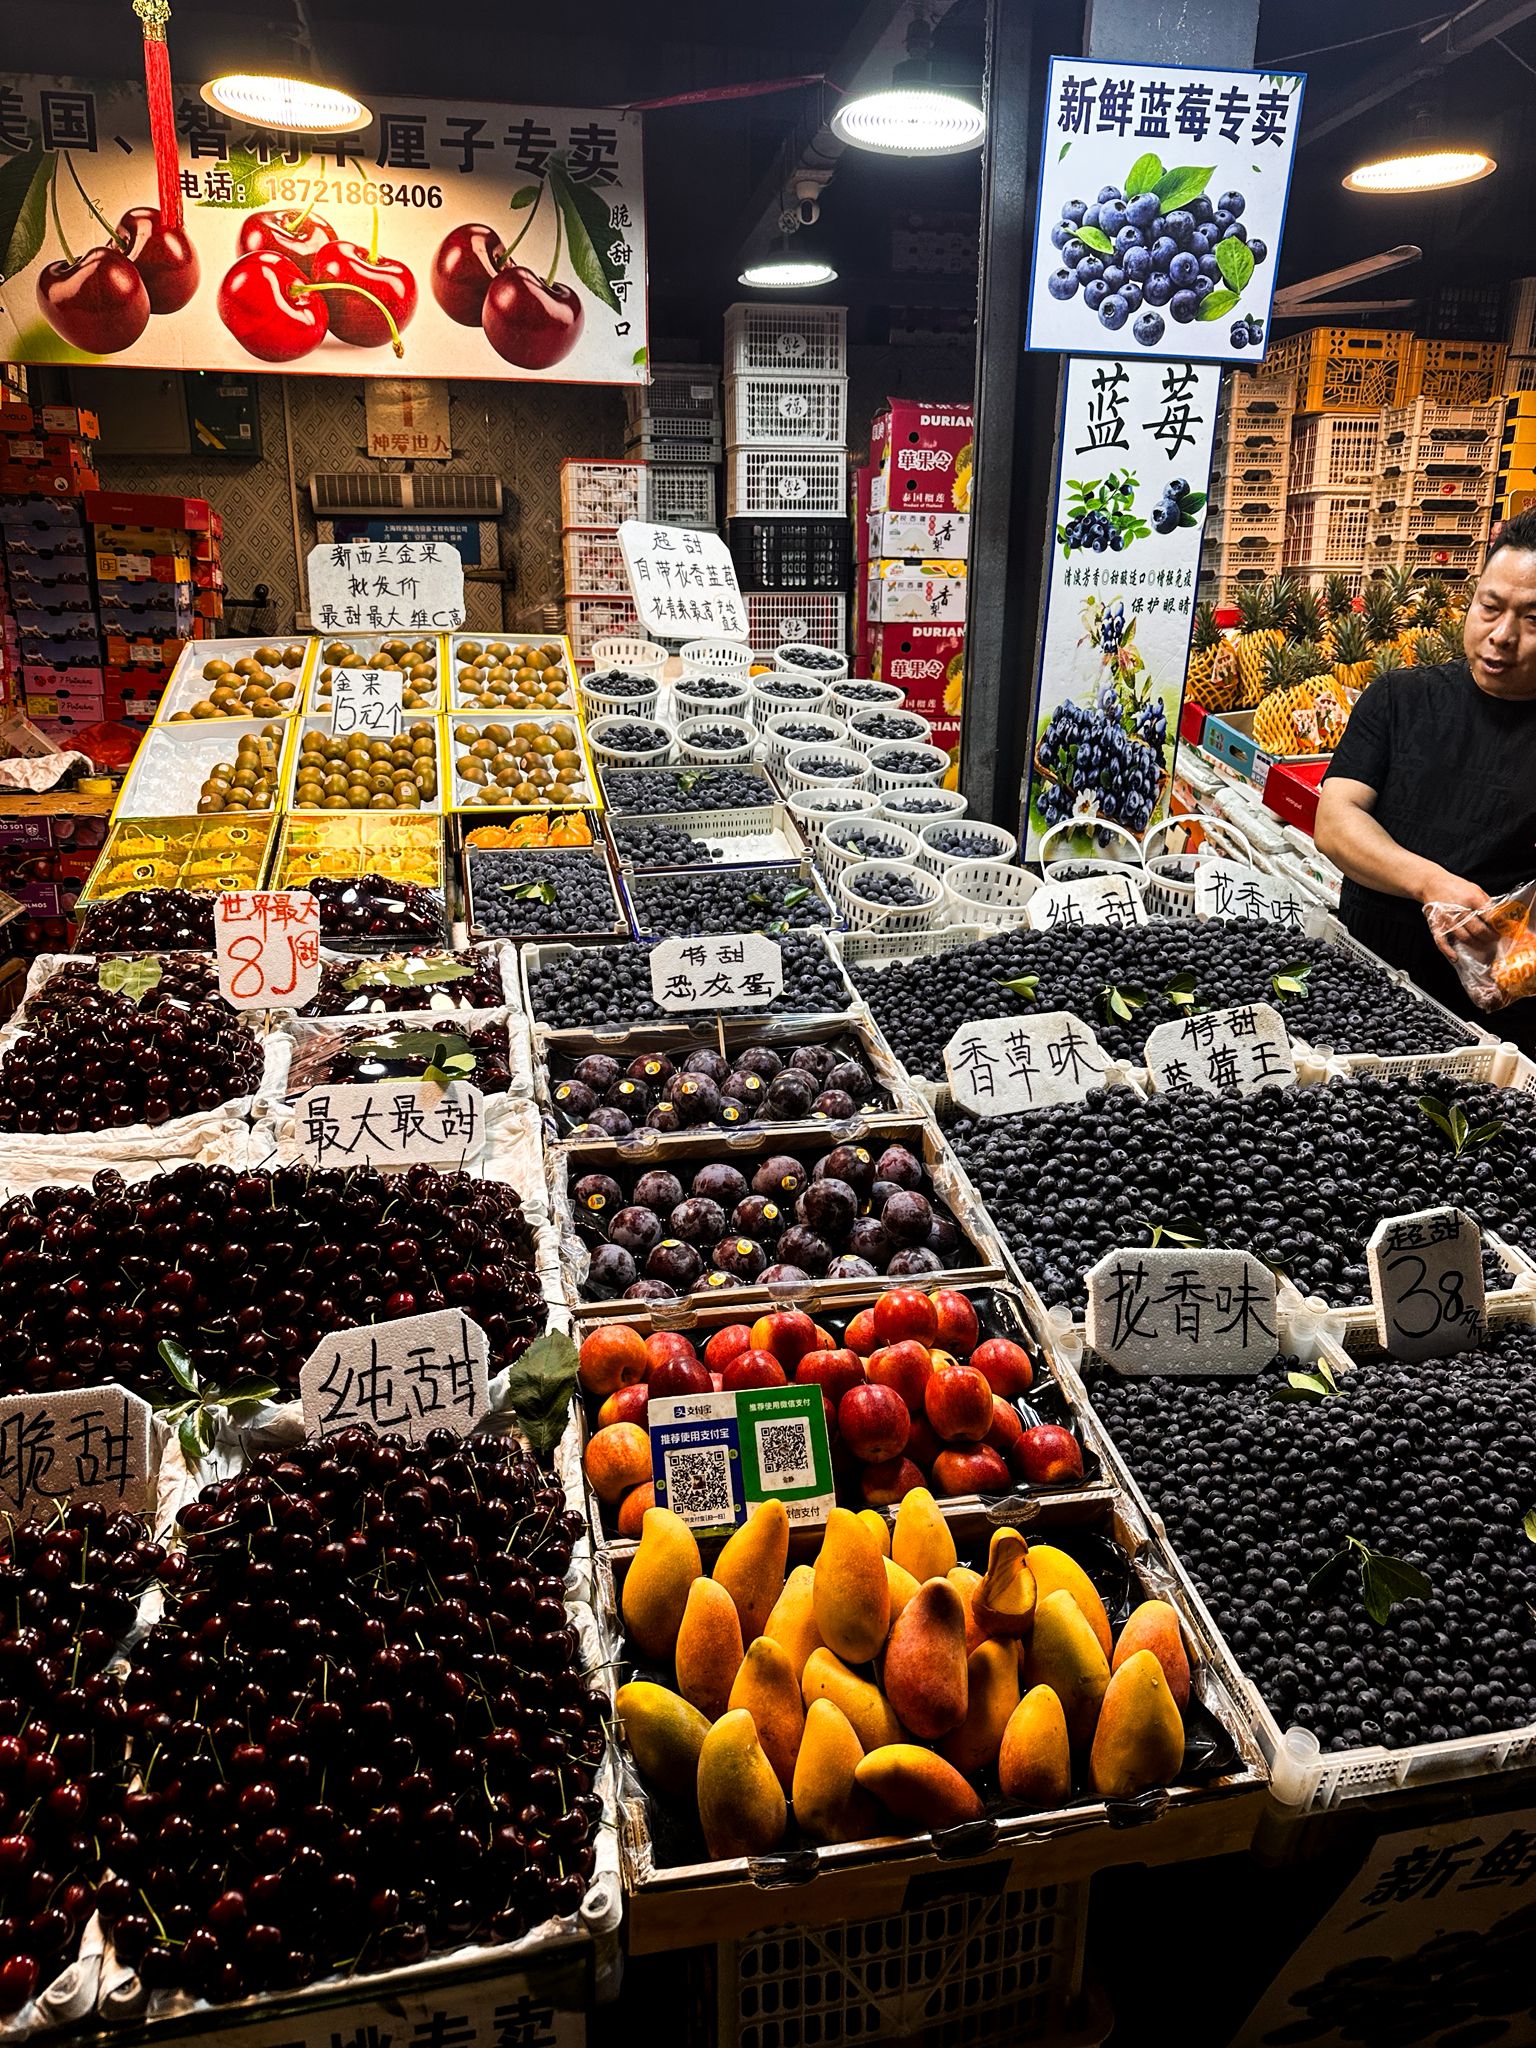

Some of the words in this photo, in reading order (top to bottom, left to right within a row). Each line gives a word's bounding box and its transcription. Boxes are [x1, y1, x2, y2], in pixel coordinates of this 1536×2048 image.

[1057, 75, 1290, 147] 新鲜蓝莓专卖
[266, 175, 443, 209] 18721868406
[608, 205, 633, 337] 脆甜可口
[784, 398, 802, 415] 福
[920, 415, 974, 427] DURIAN
[1075, 362, 1204, 461] 蓝莓
[372, 433, 450, 454] 神爱世人
[330, 544, 442, 570] 新西兰金果
[652, 530, 703, 555] 超甜
[348, 575, 420, 600] 批发价
[633, 557, 737, 591] 自带花香蓝莓
[1131, 595, 1192, 615] 保护眼睛
[912, 627, 966, 637] DURIAN
[333, 671, 382, 697] 金果
[930, 721, 961, 732] RIAN
[1046, 880, 1138, 928] 纯甜
[1205, 871, 1304, 928] 花香味
[220, 893, 319, 942] 世界最大
[680, 941, 744, 966] 特甜
[662, 972, 775, 1002] 恐龙蛋
[1181, 1006, 1258, 1050] 特甜
[953, 1022, 1105, 1103] 香草味
[1161, 1042, 1292, 1094] 蓝莓王
[302, 1094, 478, 1163] 最大最甜
[1382, 1209, 1464, 1258] 超甜
[1105, 1261, 1276, 1351] 花香味
[318, 1318, 480, 1436] 纯甜
[687, 1404, 712, 1416] 支付宝
[749, 1399, 811, 1412] 推荐使用微信支付
[660, 1428, 730, 1445] 推荐使用支付宝
[0, 1399, 135, 1512] 脆甜
